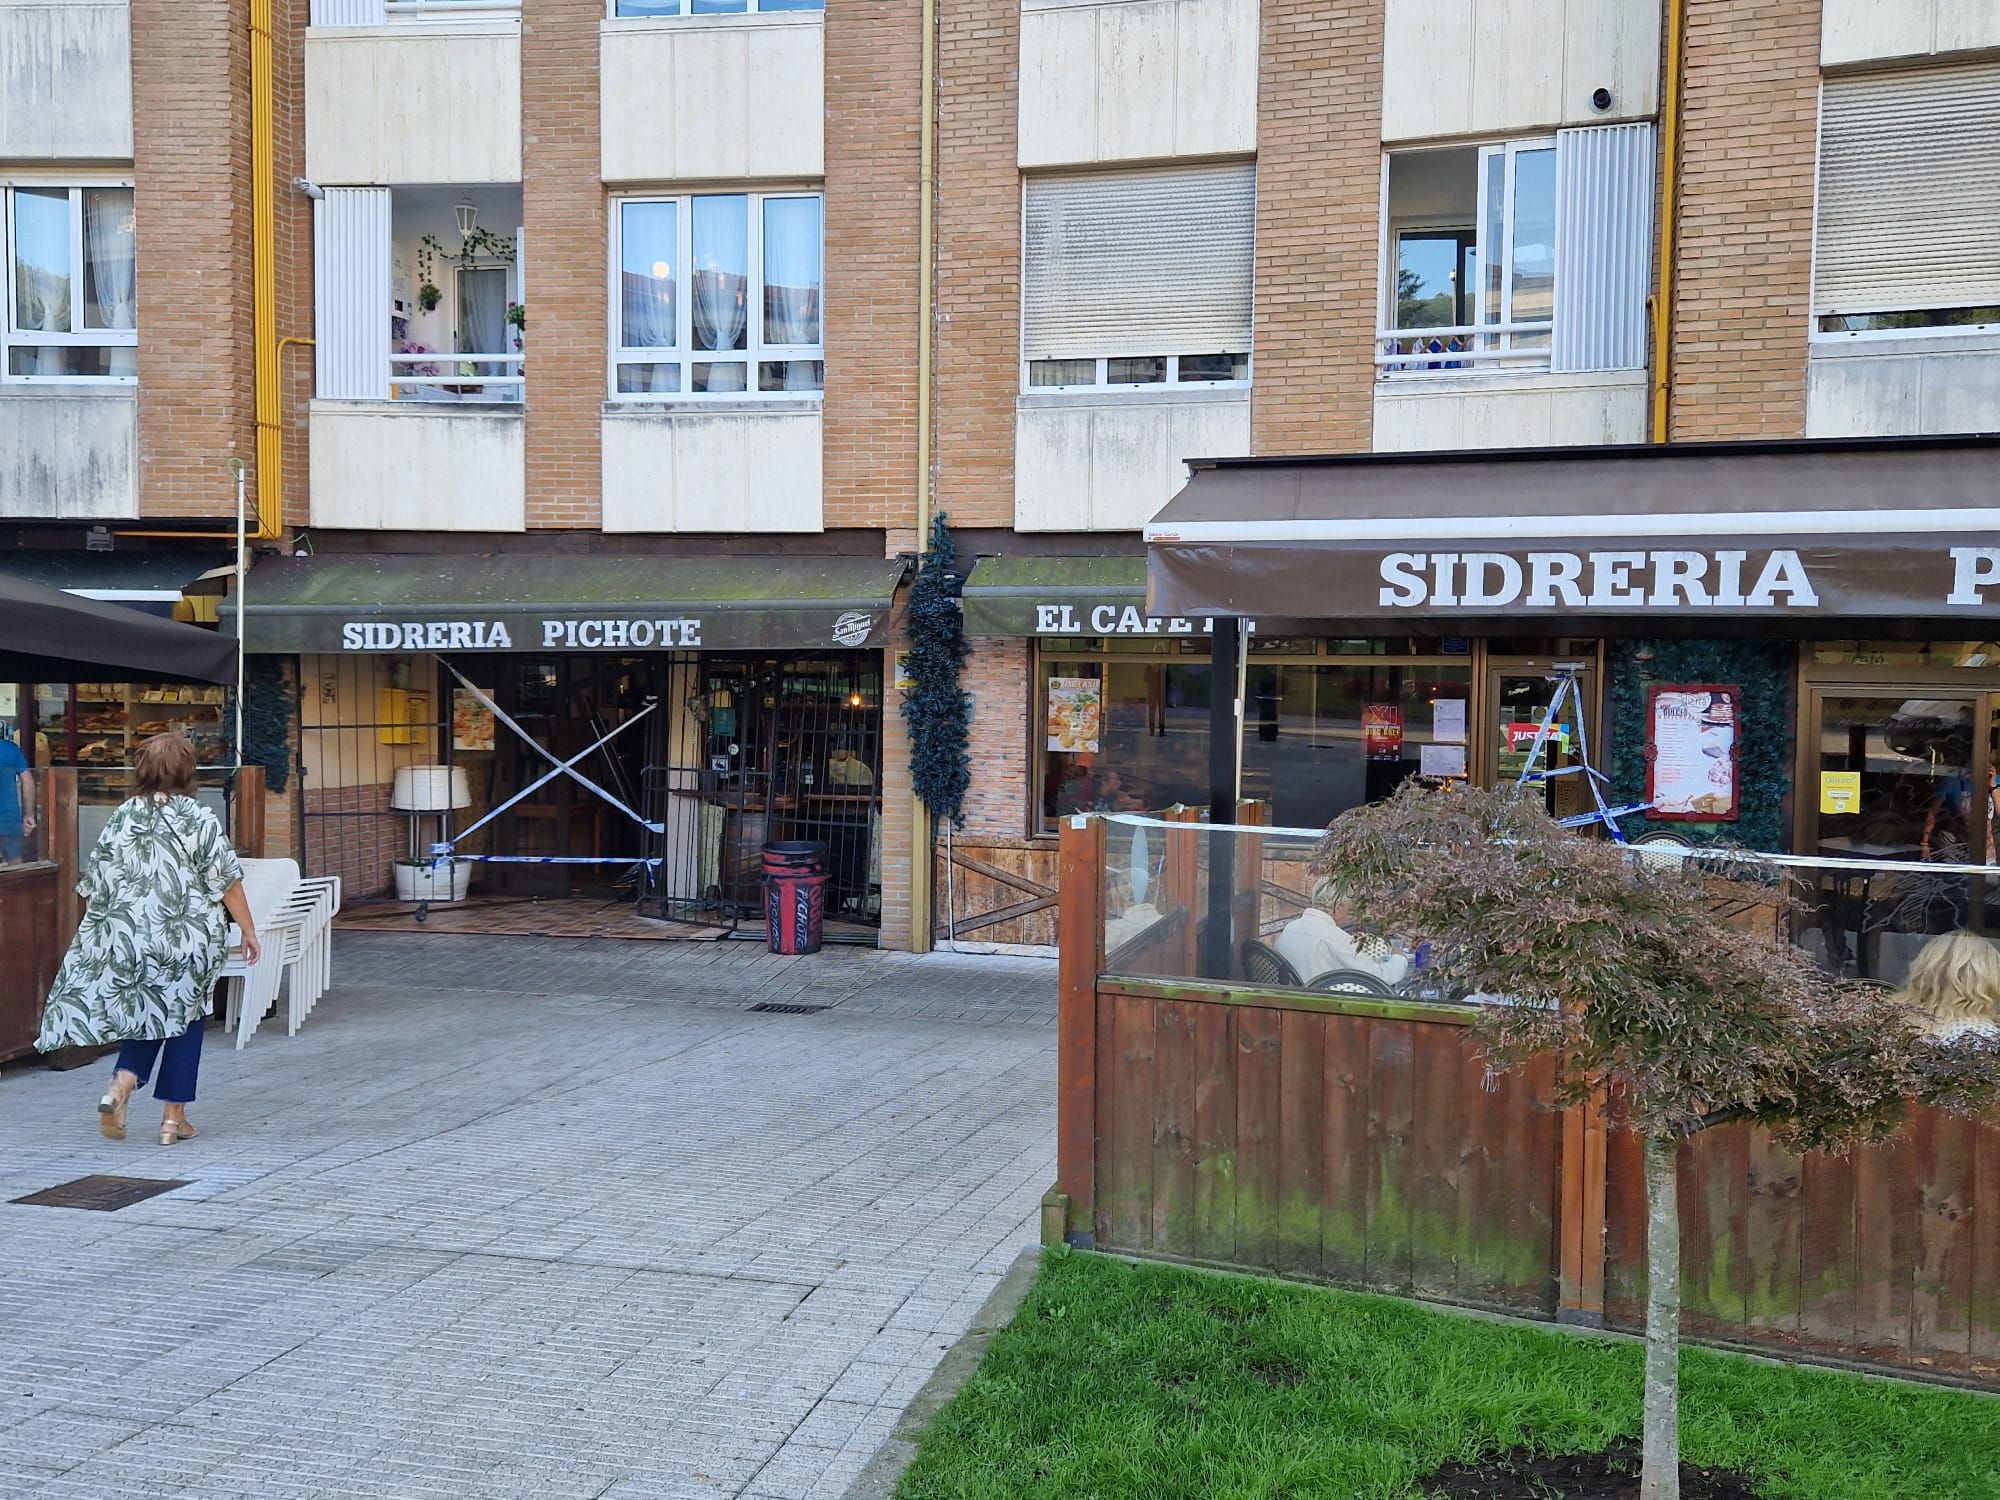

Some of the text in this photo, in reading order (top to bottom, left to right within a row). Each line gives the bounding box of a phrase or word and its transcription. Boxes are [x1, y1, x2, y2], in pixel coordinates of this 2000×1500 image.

[1379, 550, 1819, 607] SIDRERIA
[343, 619, 701, 649] SIDRERIA PICHOTE
[1036, 605, 1081, 633] EL
